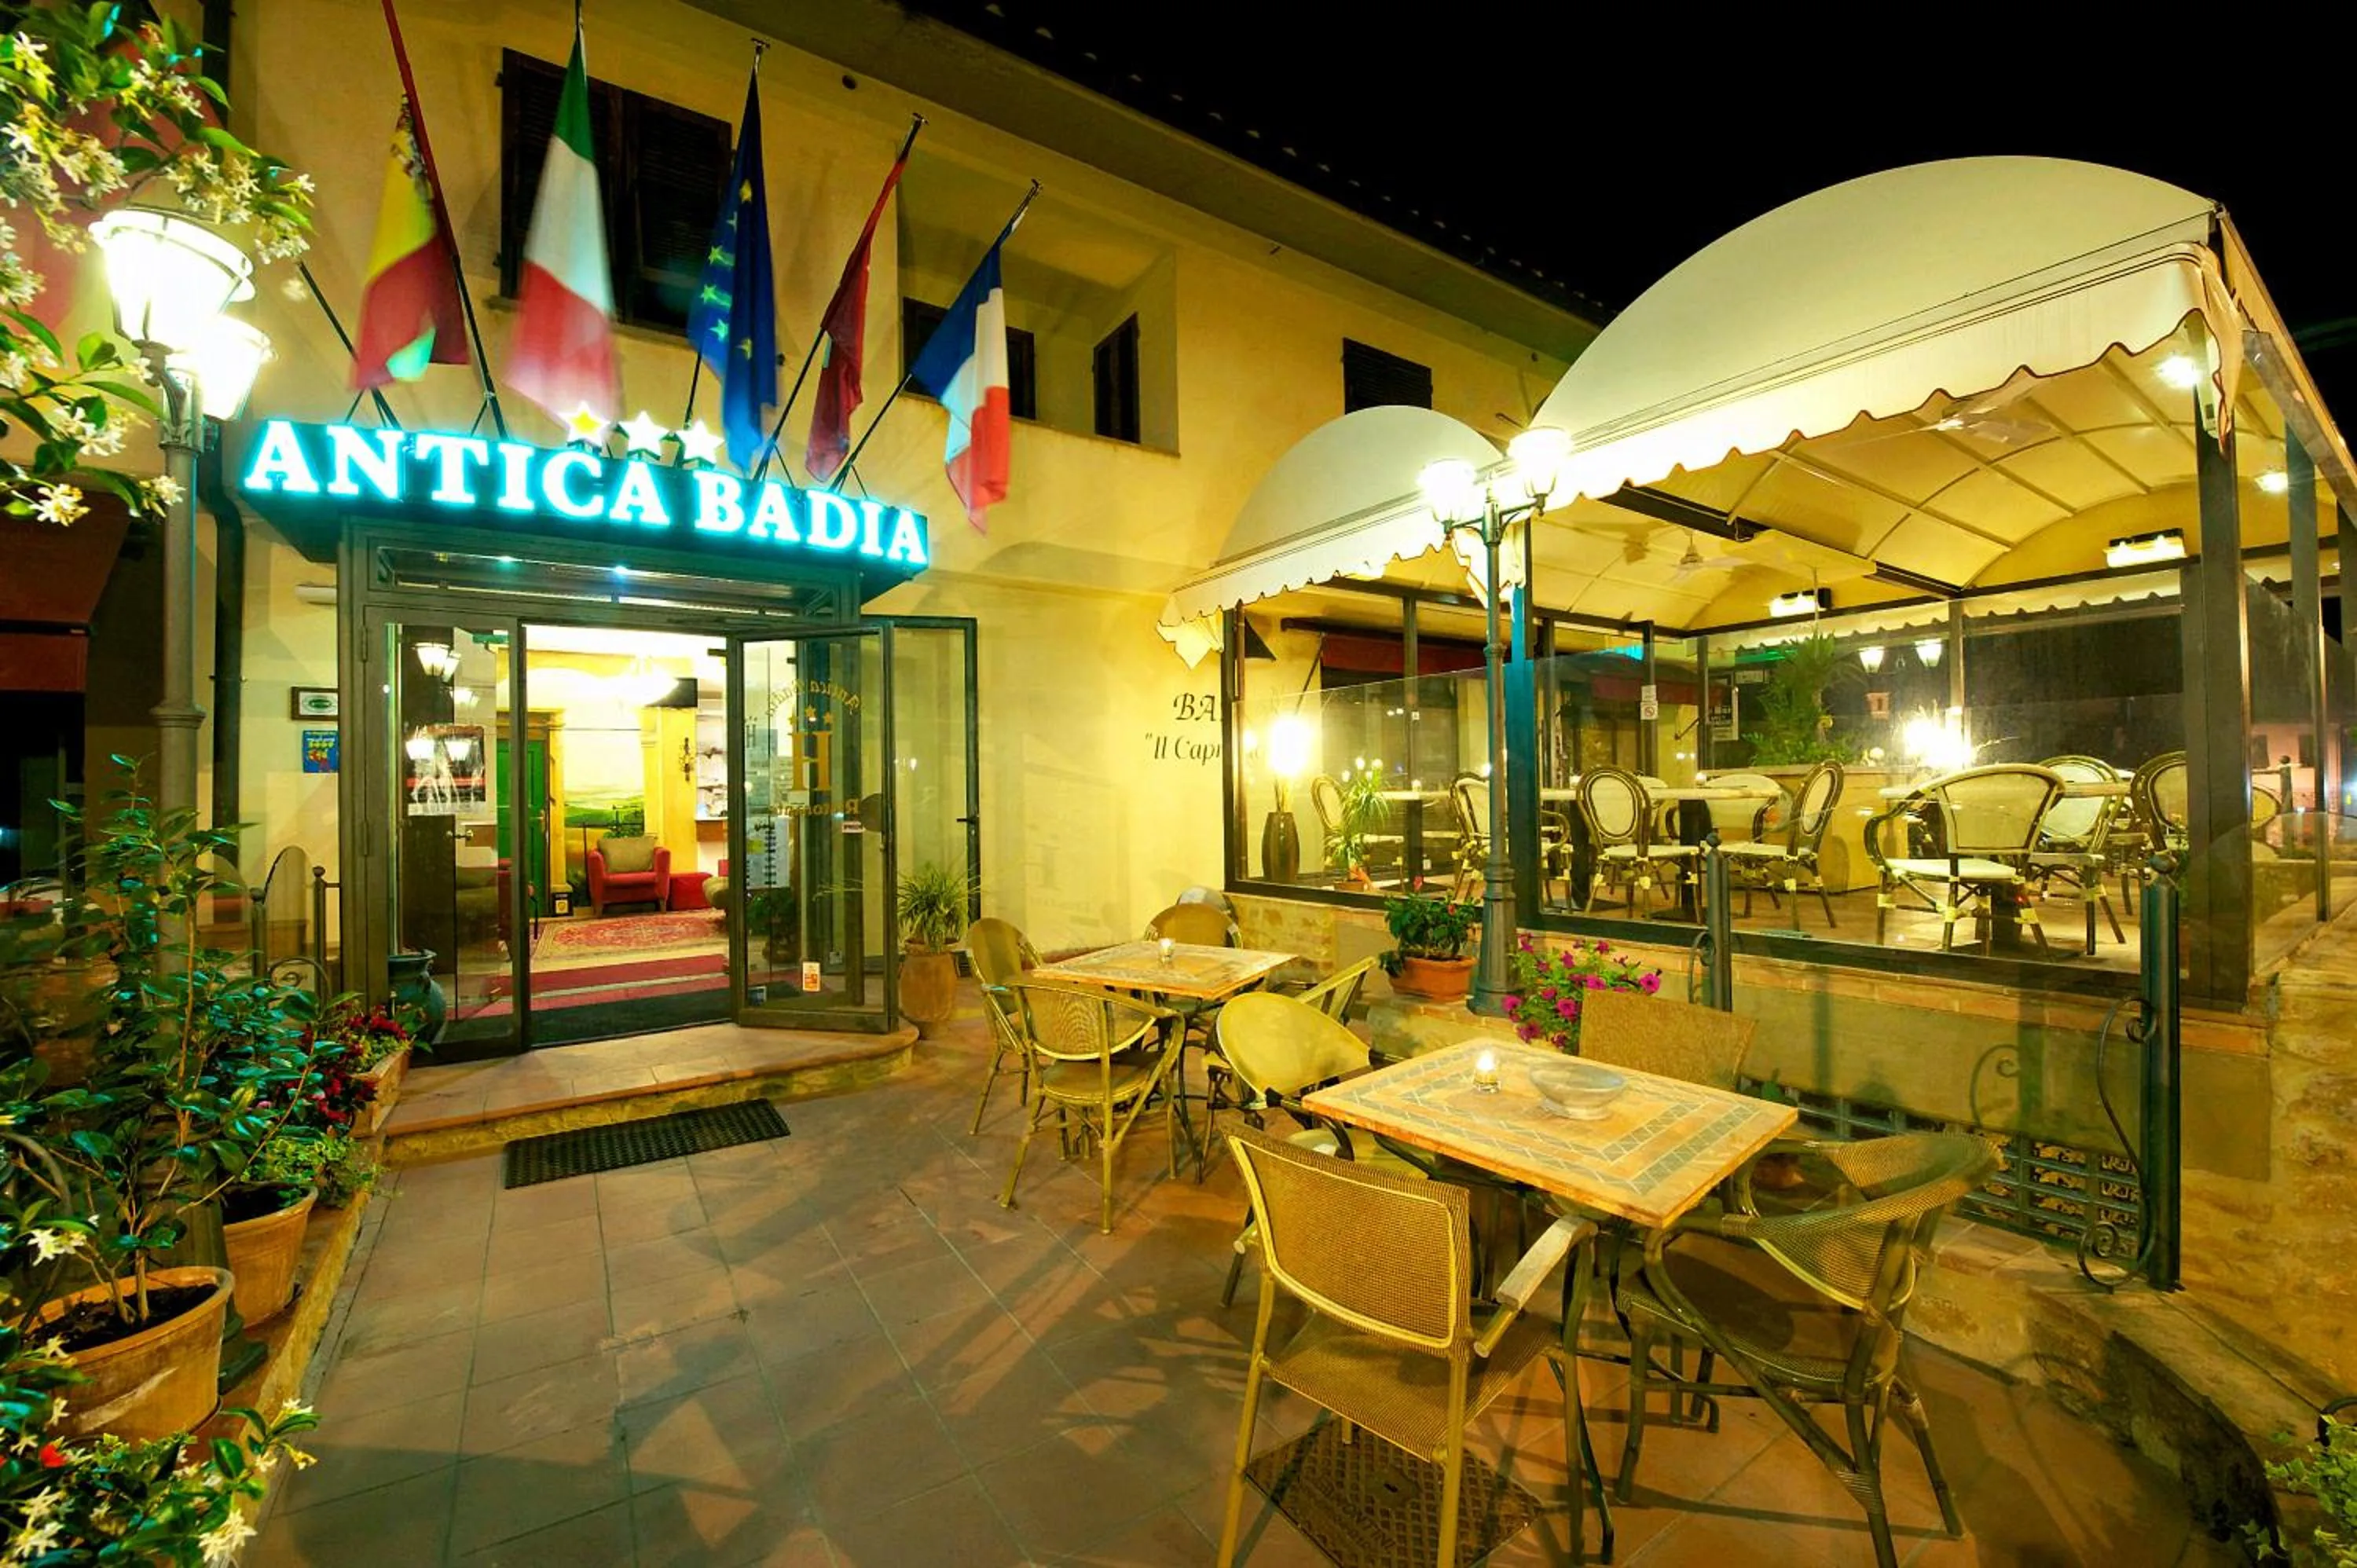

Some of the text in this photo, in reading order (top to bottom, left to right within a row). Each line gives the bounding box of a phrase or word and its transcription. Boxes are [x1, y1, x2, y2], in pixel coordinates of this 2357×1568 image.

[243, 419, 929, 564] ANTICA BADIA
[1173, 692, 1223, 722] BA
